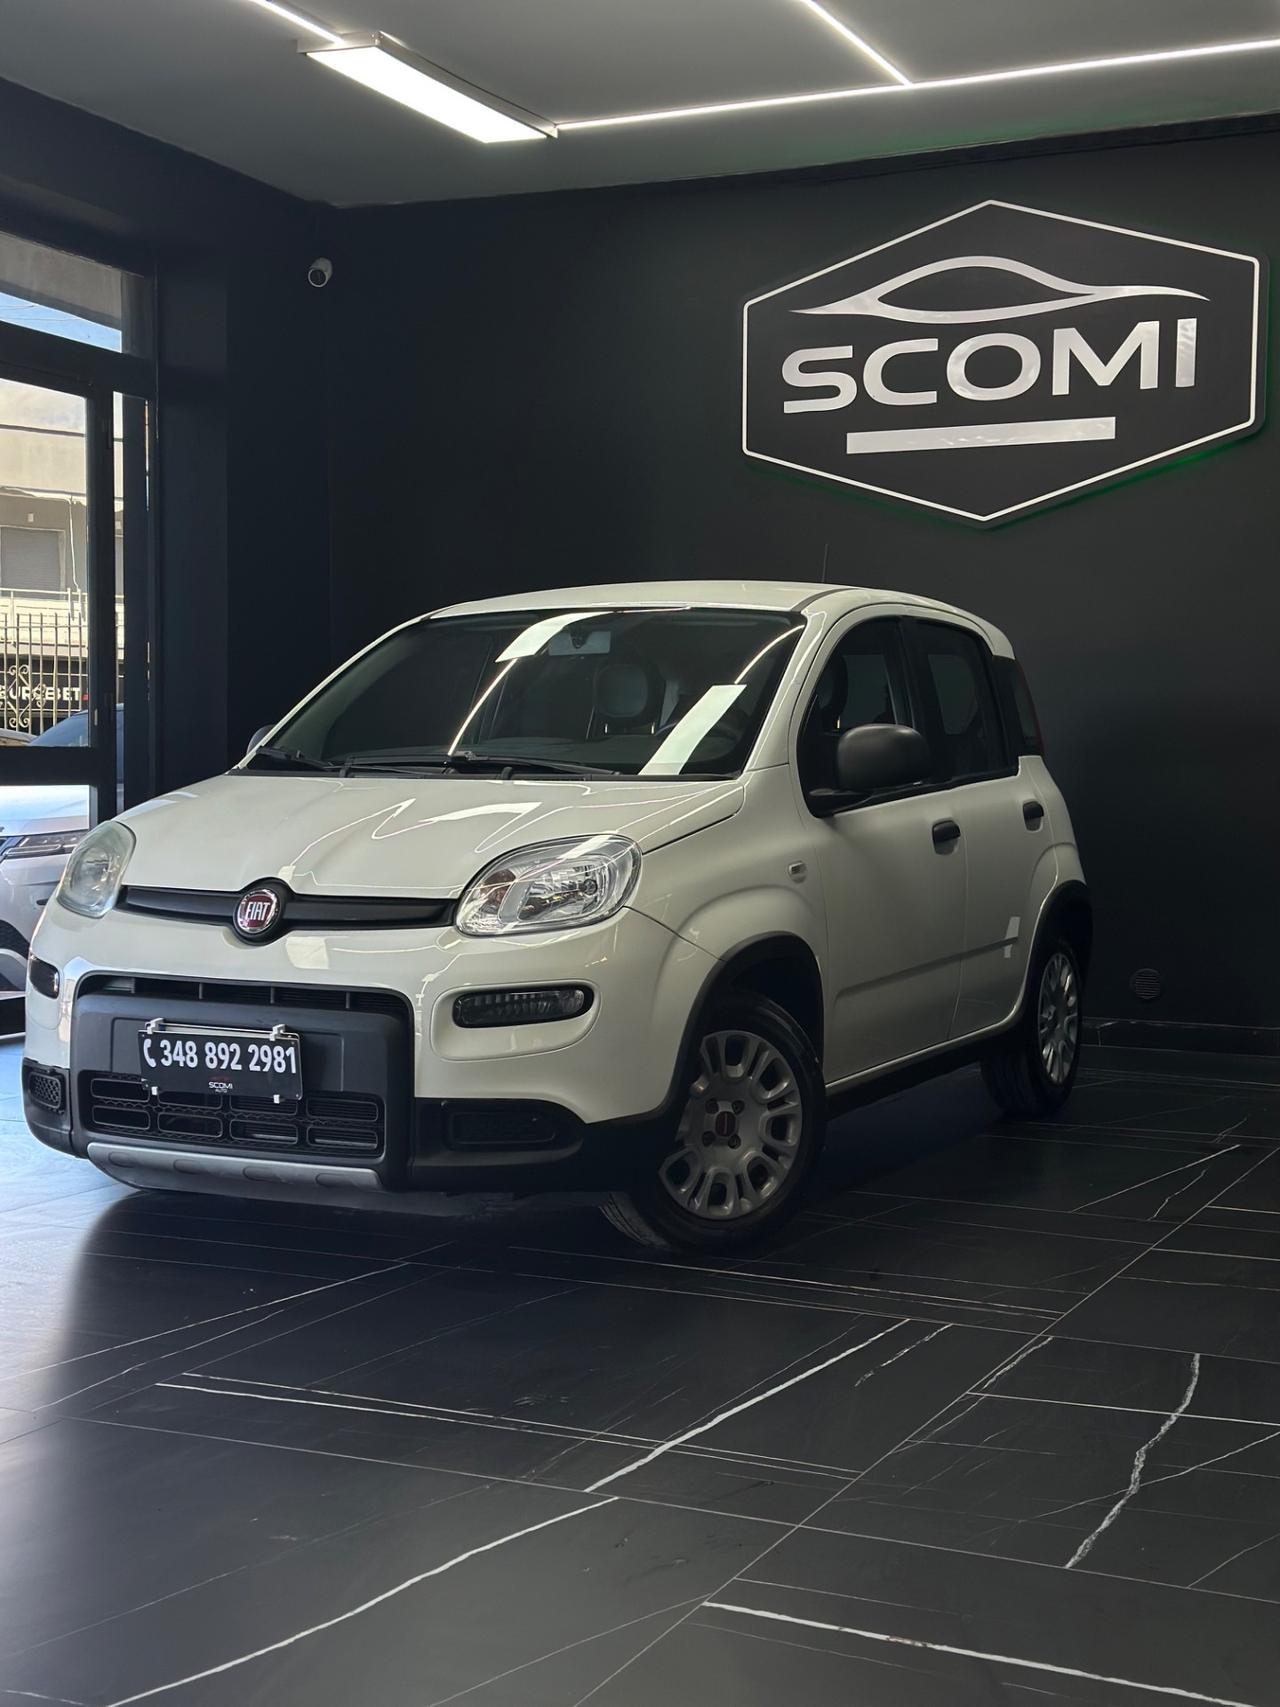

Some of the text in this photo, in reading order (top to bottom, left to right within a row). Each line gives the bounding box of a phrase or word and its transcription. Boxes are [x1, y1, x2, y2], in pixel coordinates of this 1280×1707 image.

[781, 317, 1198, 414] SCOMI
[245, 901, 271, 921] FIAT
[160, 1039, 297, 1074] 348 892 2981
[208, 1081, 233, 1090] SCOMI
